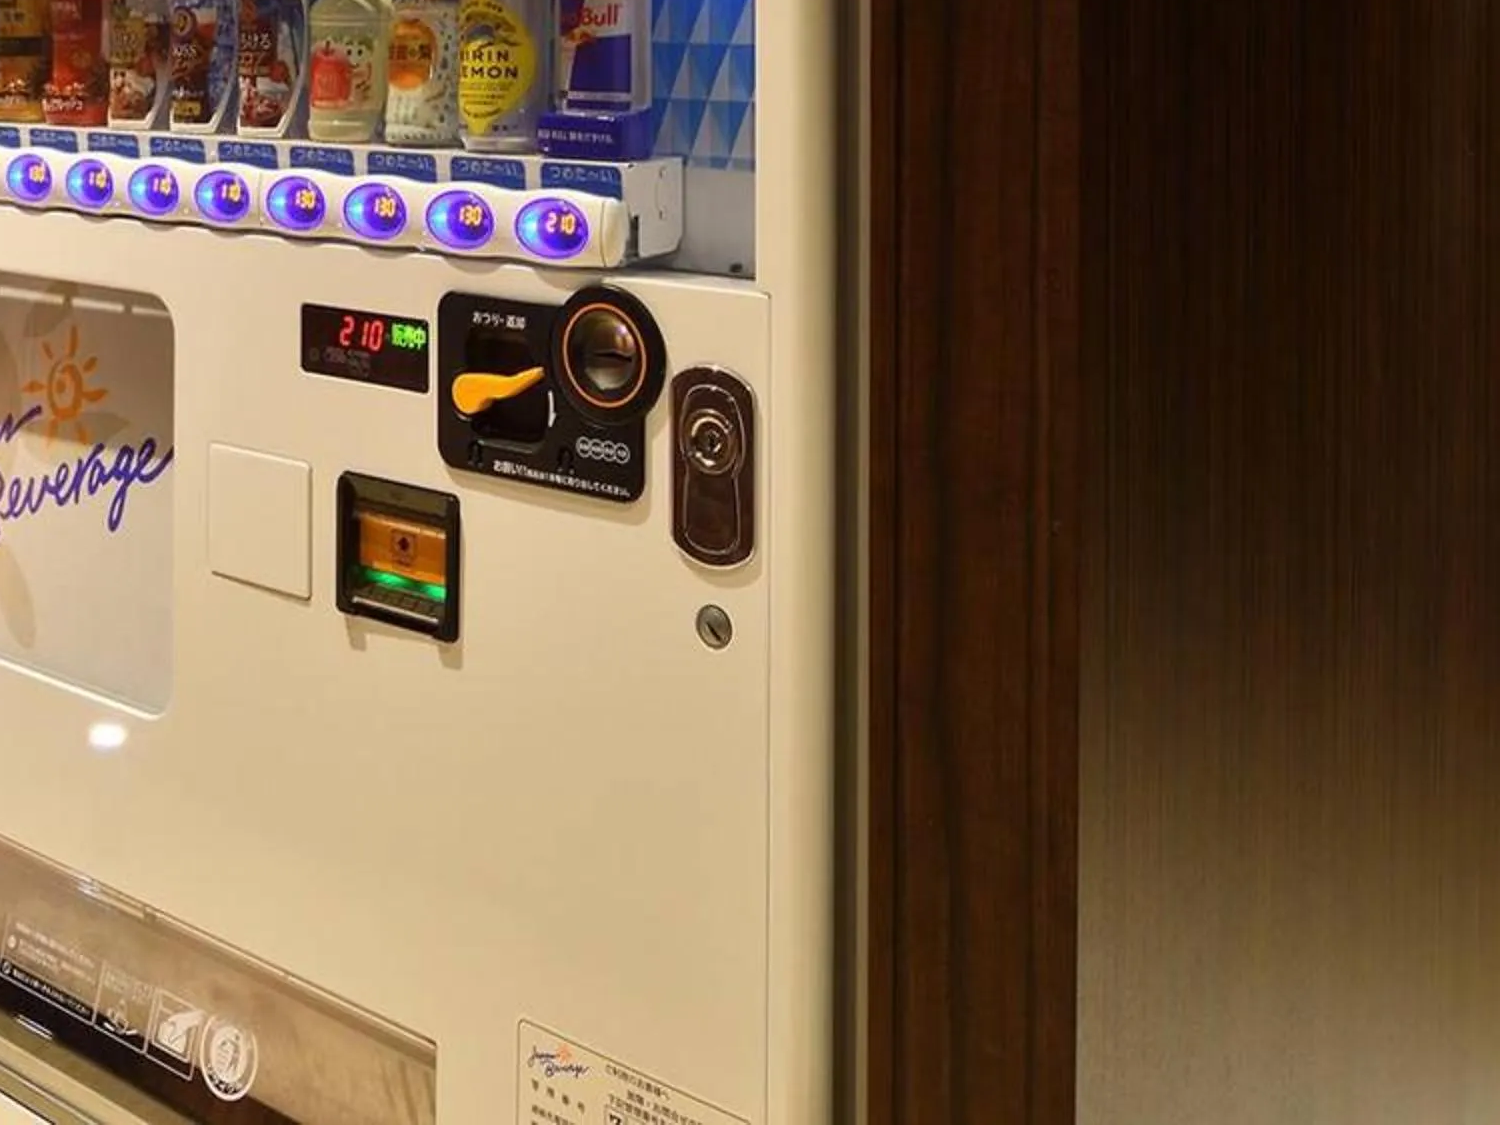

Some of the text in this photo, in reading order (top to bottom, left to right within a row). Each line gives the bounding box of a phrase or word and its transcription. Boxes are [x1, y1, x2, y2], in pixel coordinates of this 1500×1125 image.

[461, 65, 518, 79] EMON
[459, 204, 484, 227] 130
[546, 212, 577, 236] 210
[340, 315, 384, 352] 210
